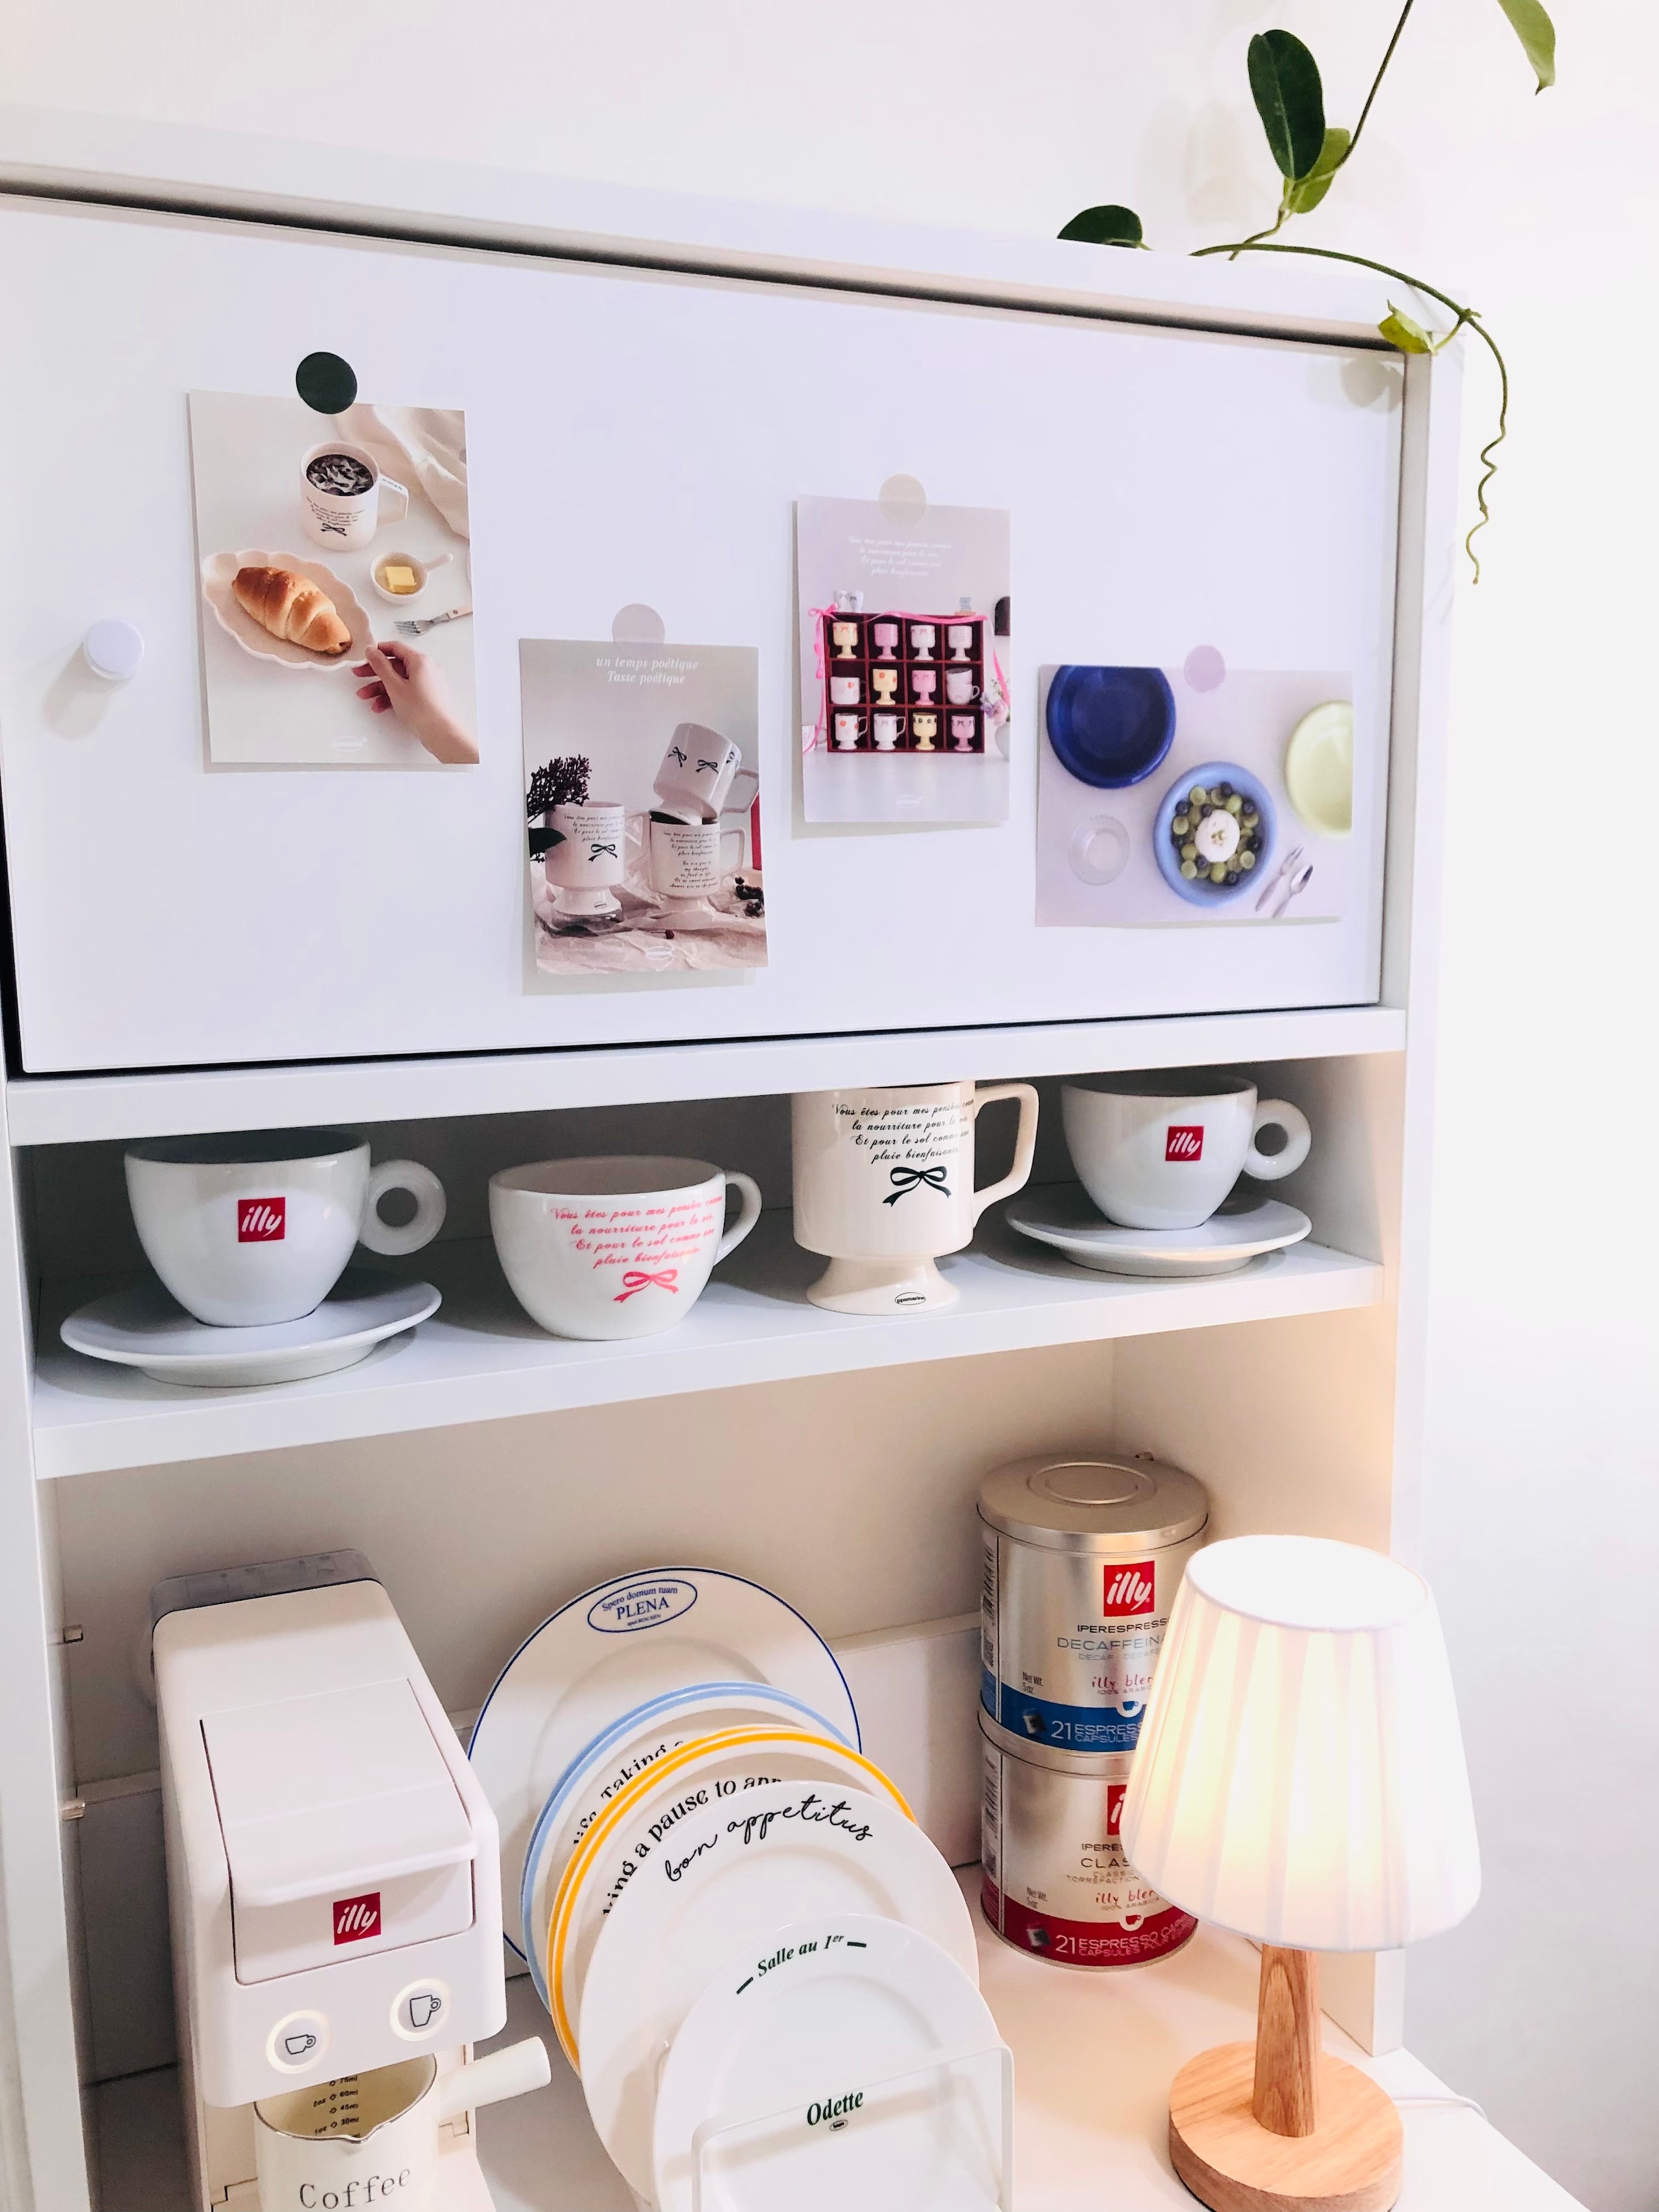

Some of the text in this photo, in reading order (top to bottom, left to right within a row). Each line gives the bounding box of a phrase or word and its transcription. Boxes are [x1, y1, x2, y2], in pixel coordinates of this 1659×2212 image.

[596, 656, 699, 672] un temps poétique
[607, 670, 686, 686] Tasse poétique
[832, 1104, 855, 1115] Vous
[861, 1108, 879, 1116] êtes
[881, 1110, 908, 1120] pour
[852, 1120, 863, 1130] la
[867, 1121, 922, 1130] nourriture
[923, 1121, 946, 1133] pour
[851, 1134, 869, 1146] Et
[870, 1139, 897, 1150] pour
[902, 1134, 911, 1144] le
[914, 1133, 931, 1144] sol
[1168, 1132, 1201, 1158] illy
[871, 1149, 901, 1164] pluie
[241, 1205, 283, 1237] illy
[551, 1207, 579, 1220] Vous
[585, 1209, 608, 1218] êtes
[610, 1209, 642, 1222] pour
[646, 1207, 666, 1216] mes
[571, 1224, 584, 1235] la
[589, 1224, 656, 1235] nourriture
[658, 1220, 685, 1235] pour
[570, 1239, 592, 1250] Et
[593, 1242, 627, 1253] pour
[632, 1237, 644, 1248] le
[647, 1234, 664, 1246] sol
[670, 1233, 701, 1244] comme
[593, 1253, 629, 1269] pluie
[602, 1596, 625, 1612] Spero
[627, 1589, 656, 1600] domum
[1107, 1572, 1152, 1611] illy
[616, 1596, 669, 1620] PLENA
[1078, 1618, 1169, 1633] IPERESPRESS
[1058, 1633, 1165, 1651] DECAFFEIN
[1092, 1676, 1115, 1690] illy
[1051, 1720, 1071, 1741] 21
[635, 1843, 651, 1857] a
[648, 1789, 709, 1843] pause
[715, 1780, 736, 1798] to
[665, 1794, 873, 1881] bon appetitus
[1096, 1892, 1119, 1905] illy
[337, 1903, 377, 1935] illy
[1056, 1935, 1076, 1955] 21
[1078, 1931, 1158, 1950] ESPRESSO
[758, 1948, 794, 1977] Salle
[799, 1942, 818, 1955] au
[807, 2091, 864, 2126] Odette
[299, 2169, 410, 2209] Coffee
